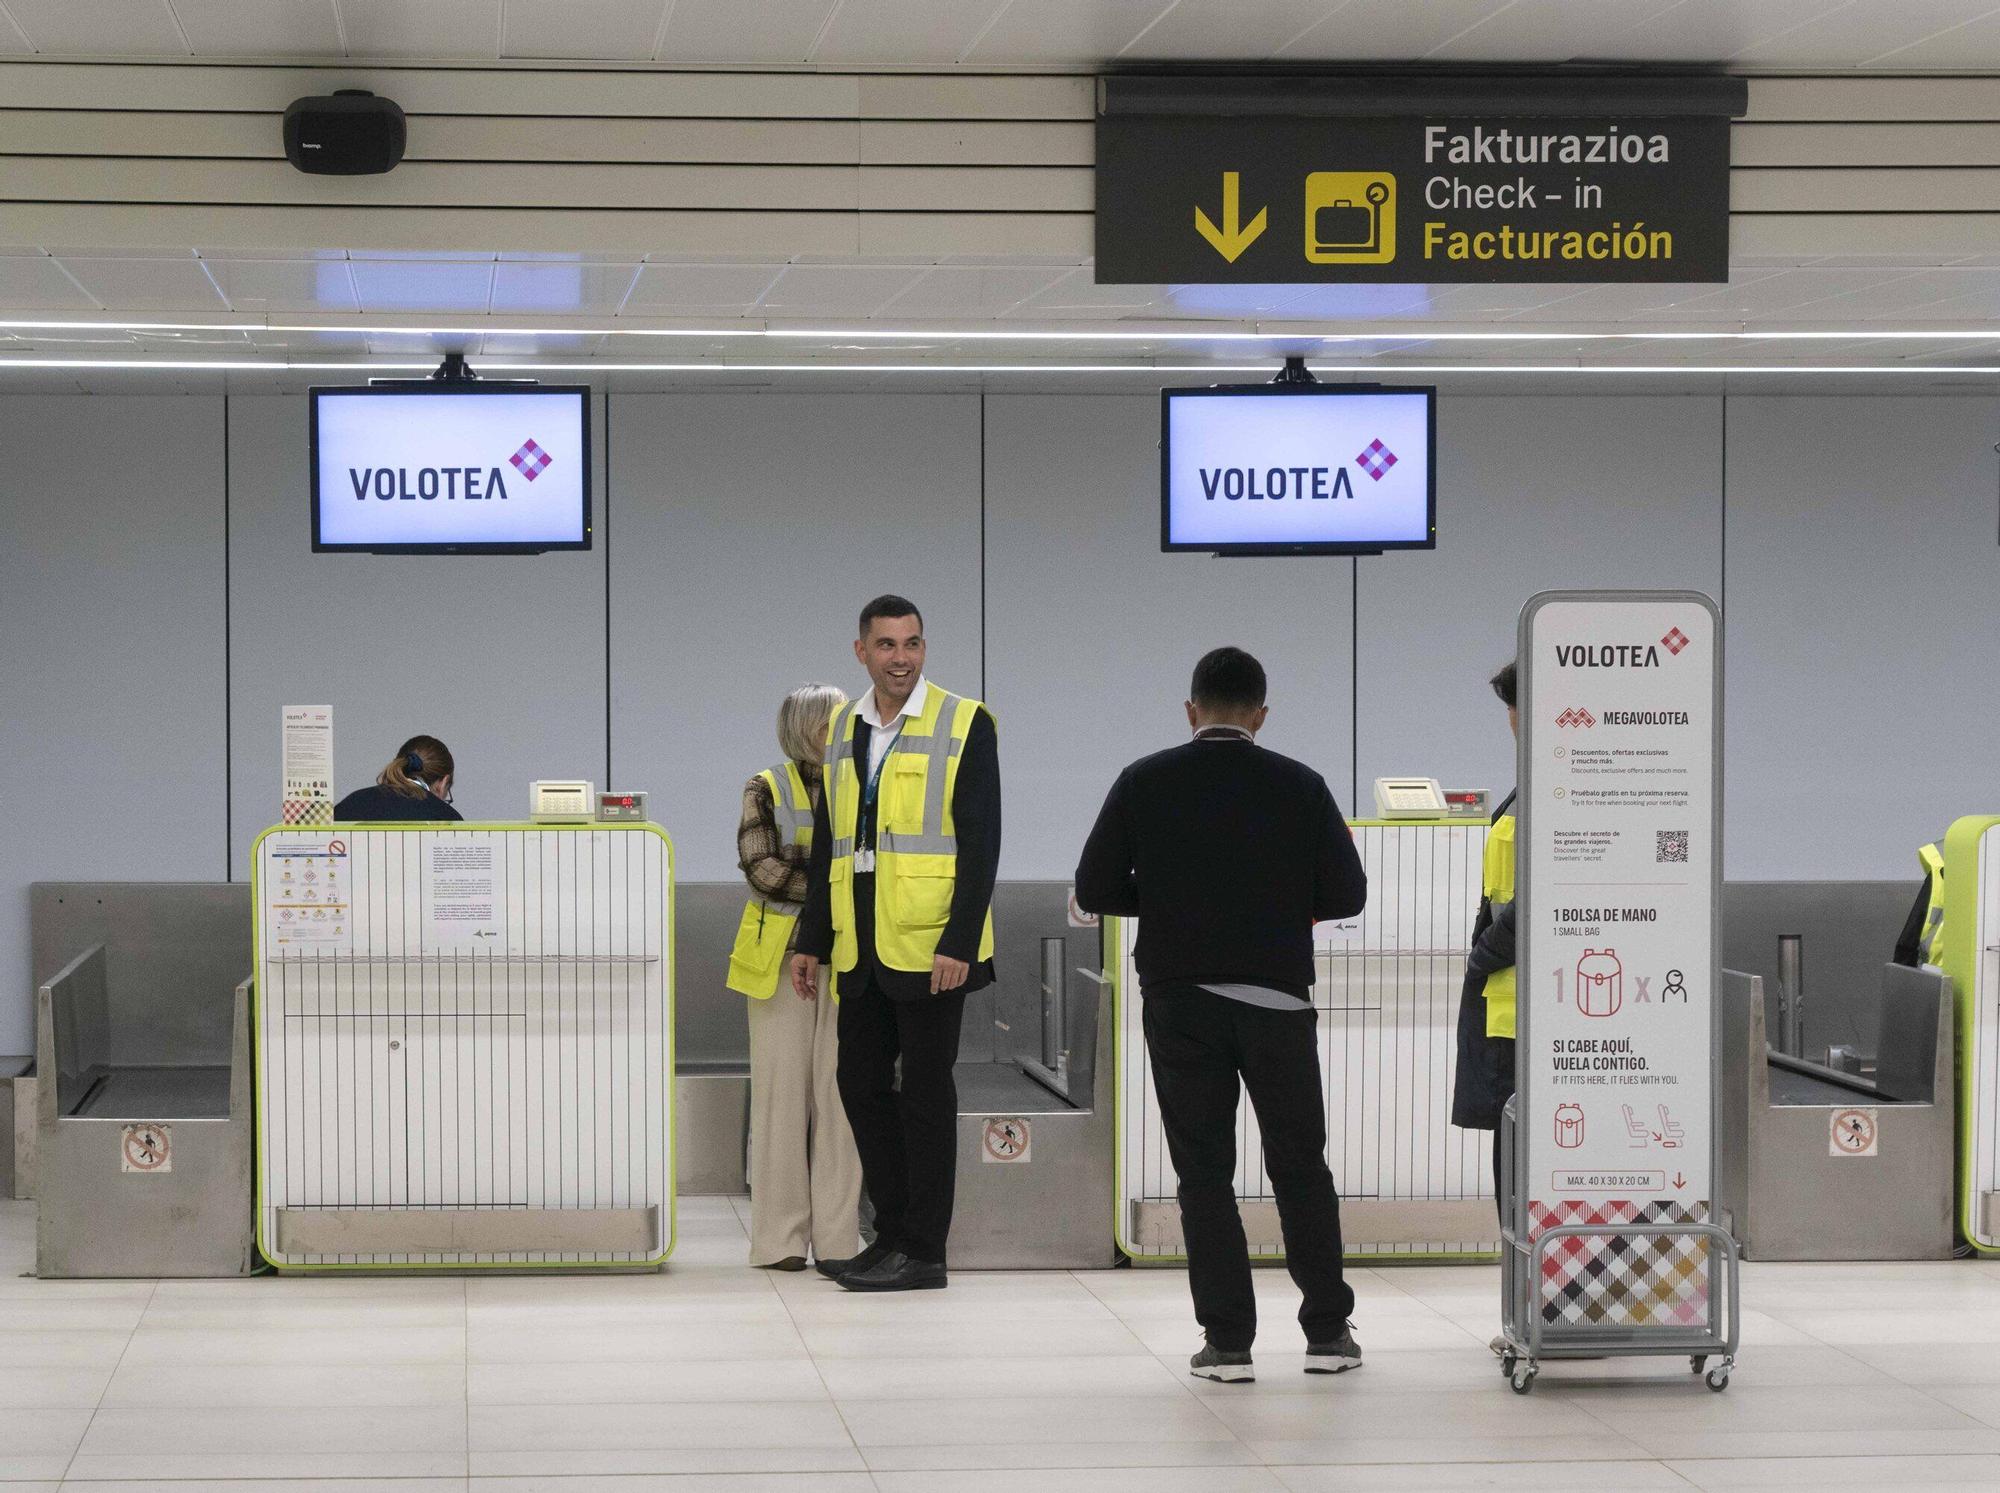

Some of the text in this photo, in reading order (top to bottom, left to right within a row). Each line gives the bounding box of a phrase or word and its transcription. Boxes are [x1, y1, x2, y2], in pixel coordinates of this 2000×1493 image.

[1425, 126, 1669, 164] Fakturazioa
[1425, 176, 1537, 210] Check
[1575, 177, 1602, 209] in
[1425, 222, 1672, 260] Facturación
[349, 467, 508, 500] VOLOTEA
[1199, 467, 1354, 500] VOLOTEA
[1556, 645, 1659, 668] VOLOTEA
[1603, 711, 1689, 725] MEGAVOLOTEA
[1571, 749, 1611, 757] Descuentos,
[1571, 789, 1600, 797] Pruébalo
[1601, 789, 1619, 798] gratis
[1637, 789, 1663, 798] próxima
[1563, 838, 1587, 846] grandes
[1591, 847, 1606, 855] great
[1553, 908, 1657, 922] 1 BOLSA DE MANO
[1558, 927, 1583, 936] SMALL
[1584, 927, 1600, 936] BAG
[1553, 967, 1564, 1004] 1
[1553, 1037, 1634, 1056] SI CABE AQUÍ,
[1553, 1056, 1649, 1071] VUELA CONTIGO.
[1553, 1075, 1679, 1086] IF IT FITS HERE, IT FLIES WITH YOU.
[1567, 1176, 1587, 1186] MAX.
[1588, 1176, 1599, 1186] 40
[1607, 1176, 1618, 1186] 30
[1625, 1176, 1636, 1186] 20
[1637, 1176, 1650, 1186] CM
